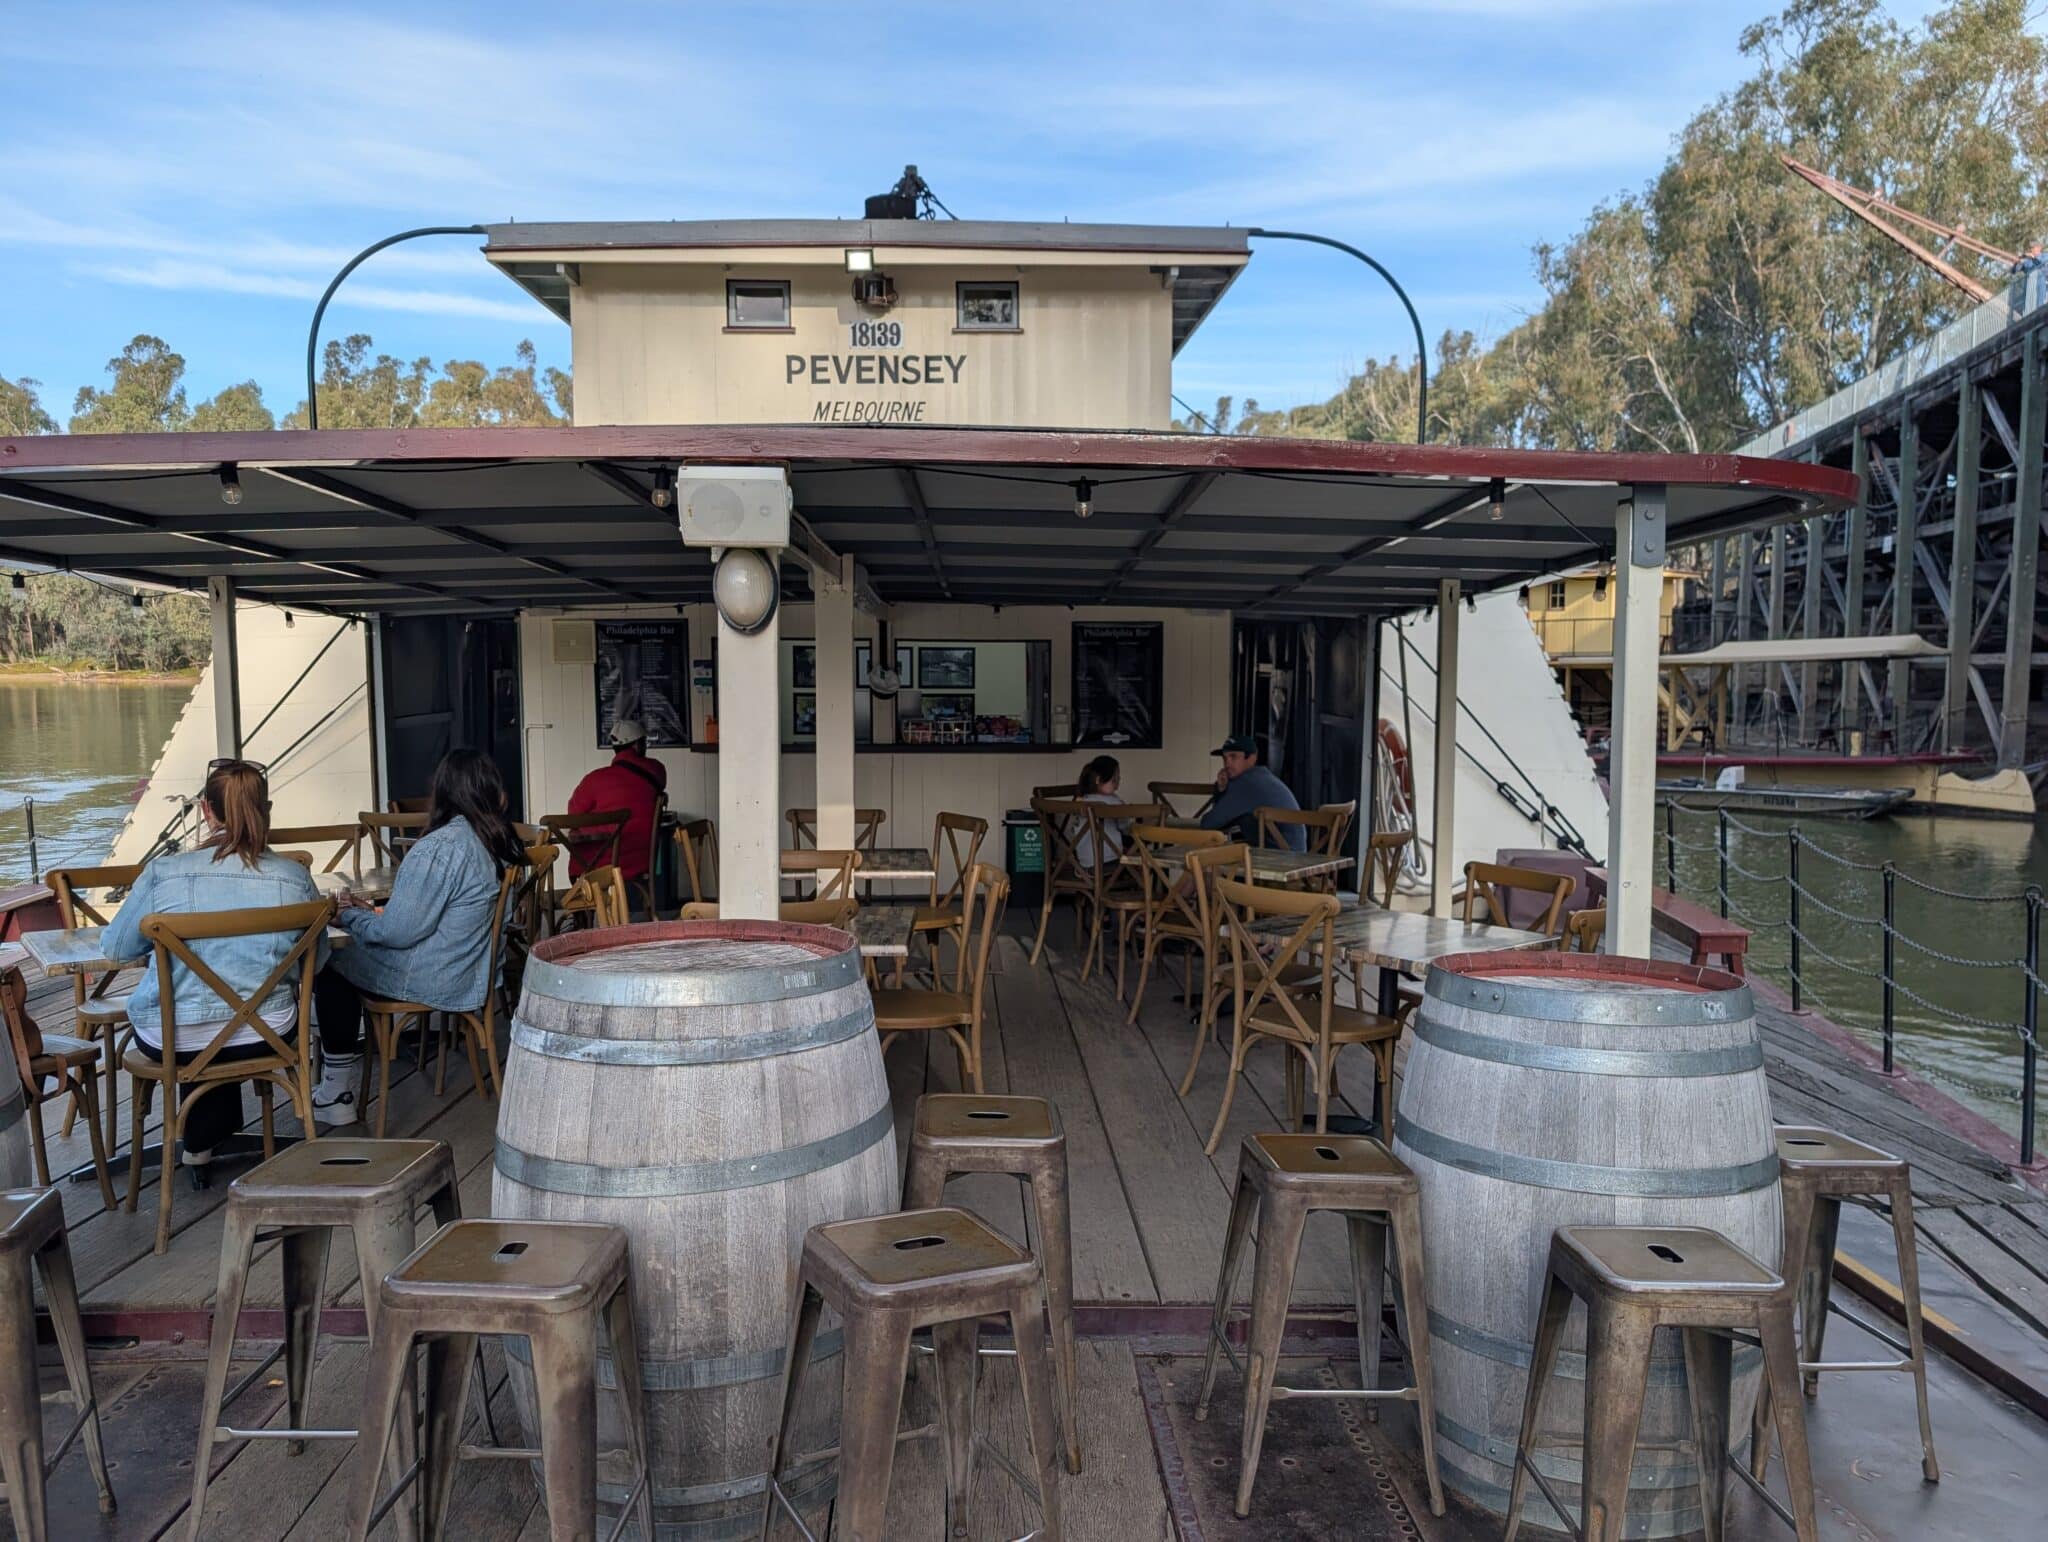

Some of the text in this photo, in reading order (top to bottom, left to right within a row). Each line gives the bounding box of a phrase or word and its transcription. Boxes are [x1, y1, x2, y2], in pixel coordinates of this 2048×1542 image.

[851, 322, 901, 347] 18139
[785, 354, 967, 385] PEVENSEY
[812, 401, 926, 423] MELBOURNE
[606, 624, 658, 636] Philadelphia
